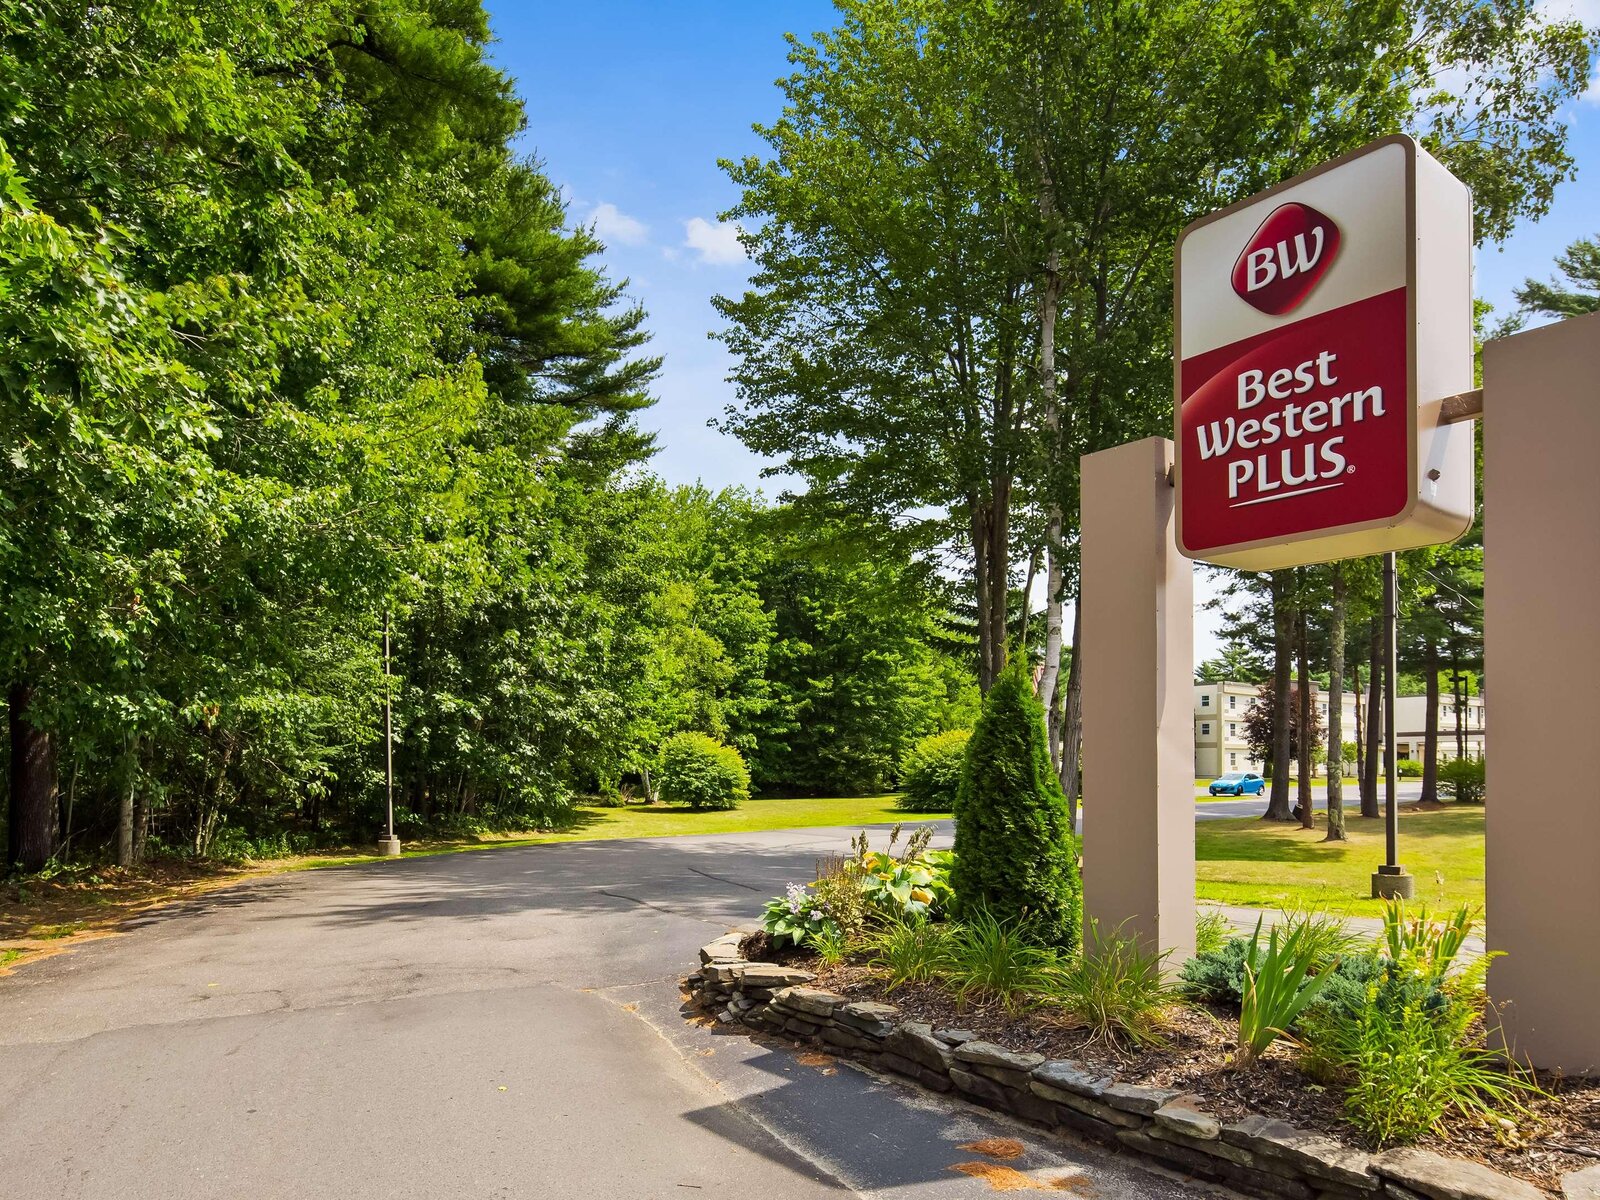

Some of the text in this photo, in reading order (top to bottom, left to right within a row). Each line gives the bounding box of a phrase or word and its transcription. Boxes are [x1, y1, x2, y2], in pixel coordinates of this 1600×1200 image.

[1247, 226, 1324, 292] BW
[1237, 350, 1338, 411] Best
[1196, 385, 1386, 461] Western
